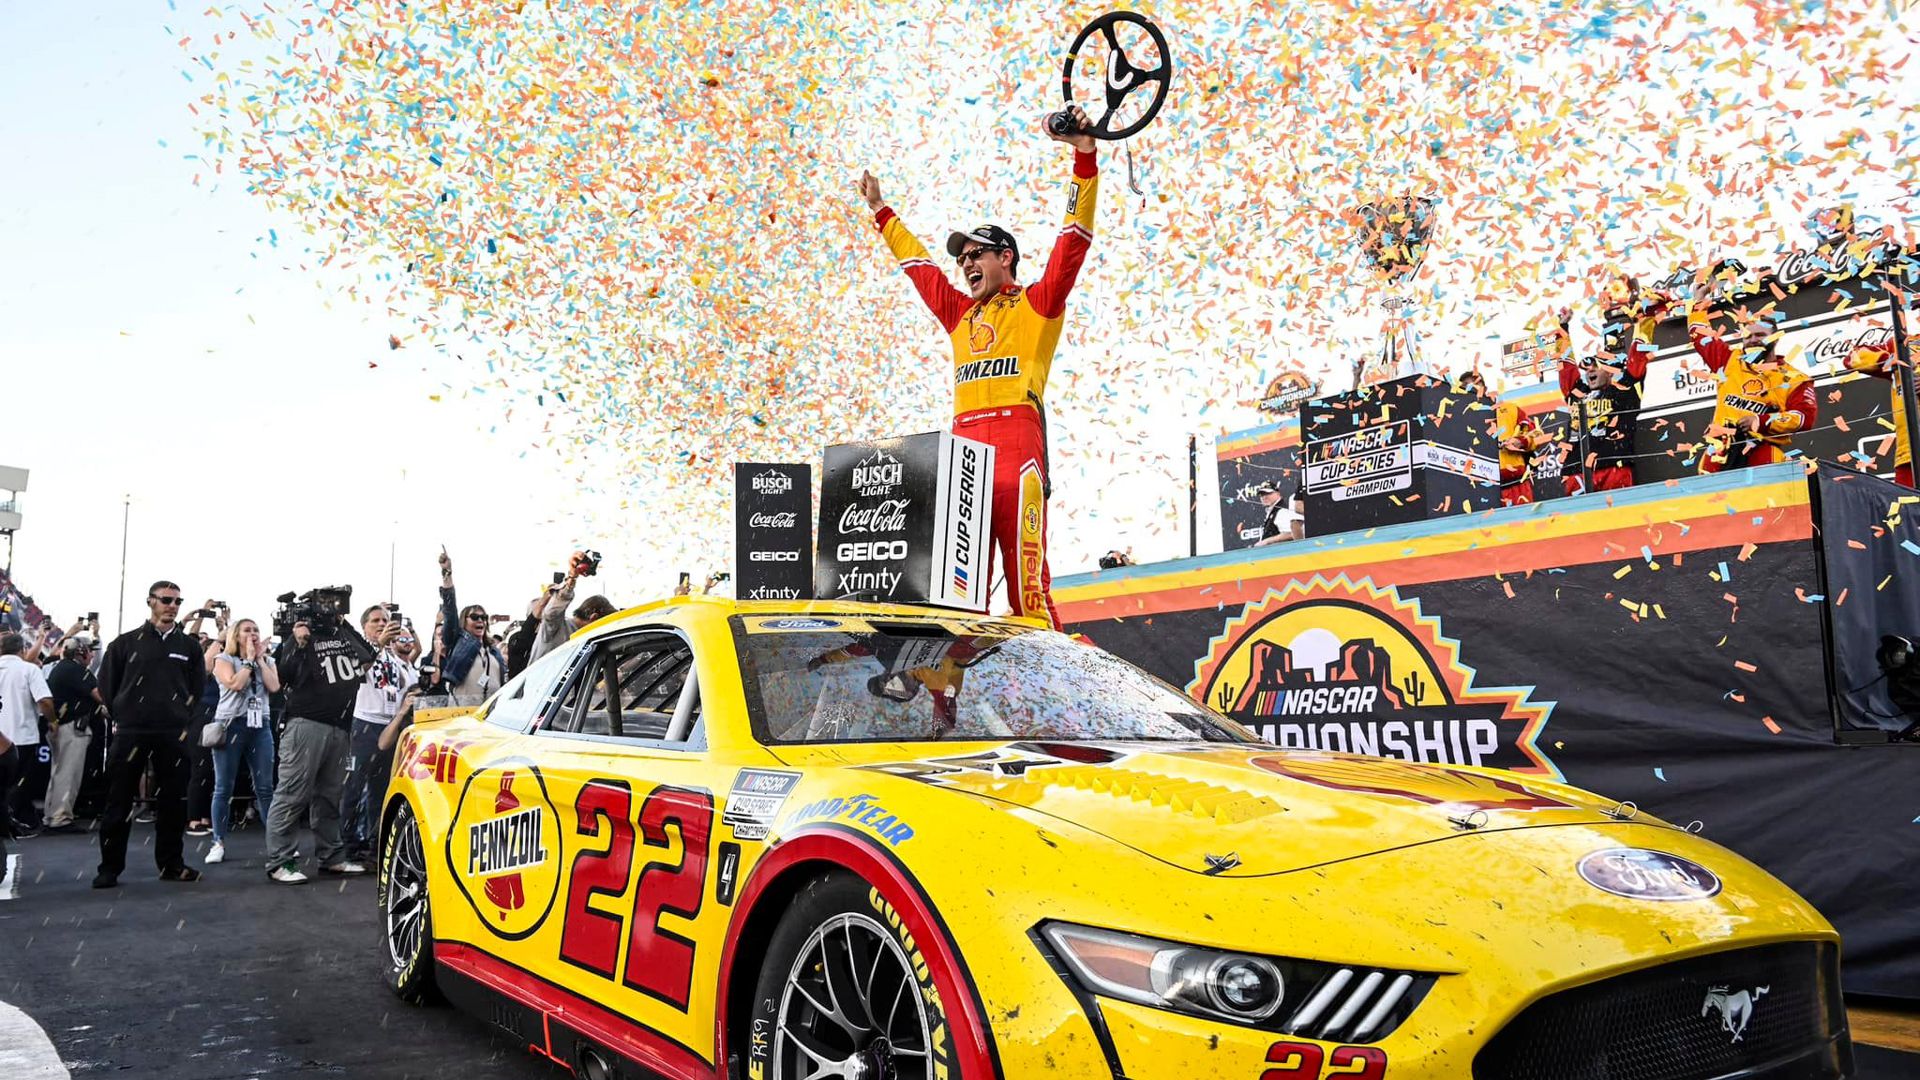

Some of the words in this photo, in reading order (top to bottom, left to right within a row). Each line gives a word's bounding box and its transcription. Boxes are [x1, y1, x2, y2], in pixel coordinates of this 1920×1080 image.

[1688, 383, 1715, 395] LIGH
[1724, 394, 1767, 415] PENNZOI
[752, 477, 792, 490] BUSCH
[852, 462, 903, 490] BUSCH
[958, 445, 976, 520] SERIES
[1320, 461, 1347, 481] CUP
[1537, 468, 1561, 479] LIGH
[860, 485, 890, 496] LIGHT
[1345, 478, 1396, 497] CHAMPION
[750, 512, 797, 528] Coca-Cola
[838, 499, 911, 534] Coca-Cola
[750, 551, 800, 562] GEICO
[837, 540, 908, 562] GEICO
[954, 520, 971, 566] CUP
[838, 566, 902, 597] xfinity
[1023, 541, 1041, 612] Shell
[750, 586, 800, 600] xfinity
[1282, 687, 1377, 716] NASCAR
[398, 731, 459, 784] hell
[783, 794, 914, 846] GOODYEAR
[380, 823, 397, 885] EAGLE
[468, 809, 546, 876] PENNZOIL
[1602, 854, 1701, 892] Ford
[559, 778, 714, 1014] 22
[1258, 1040, 1387, 1080] 22
